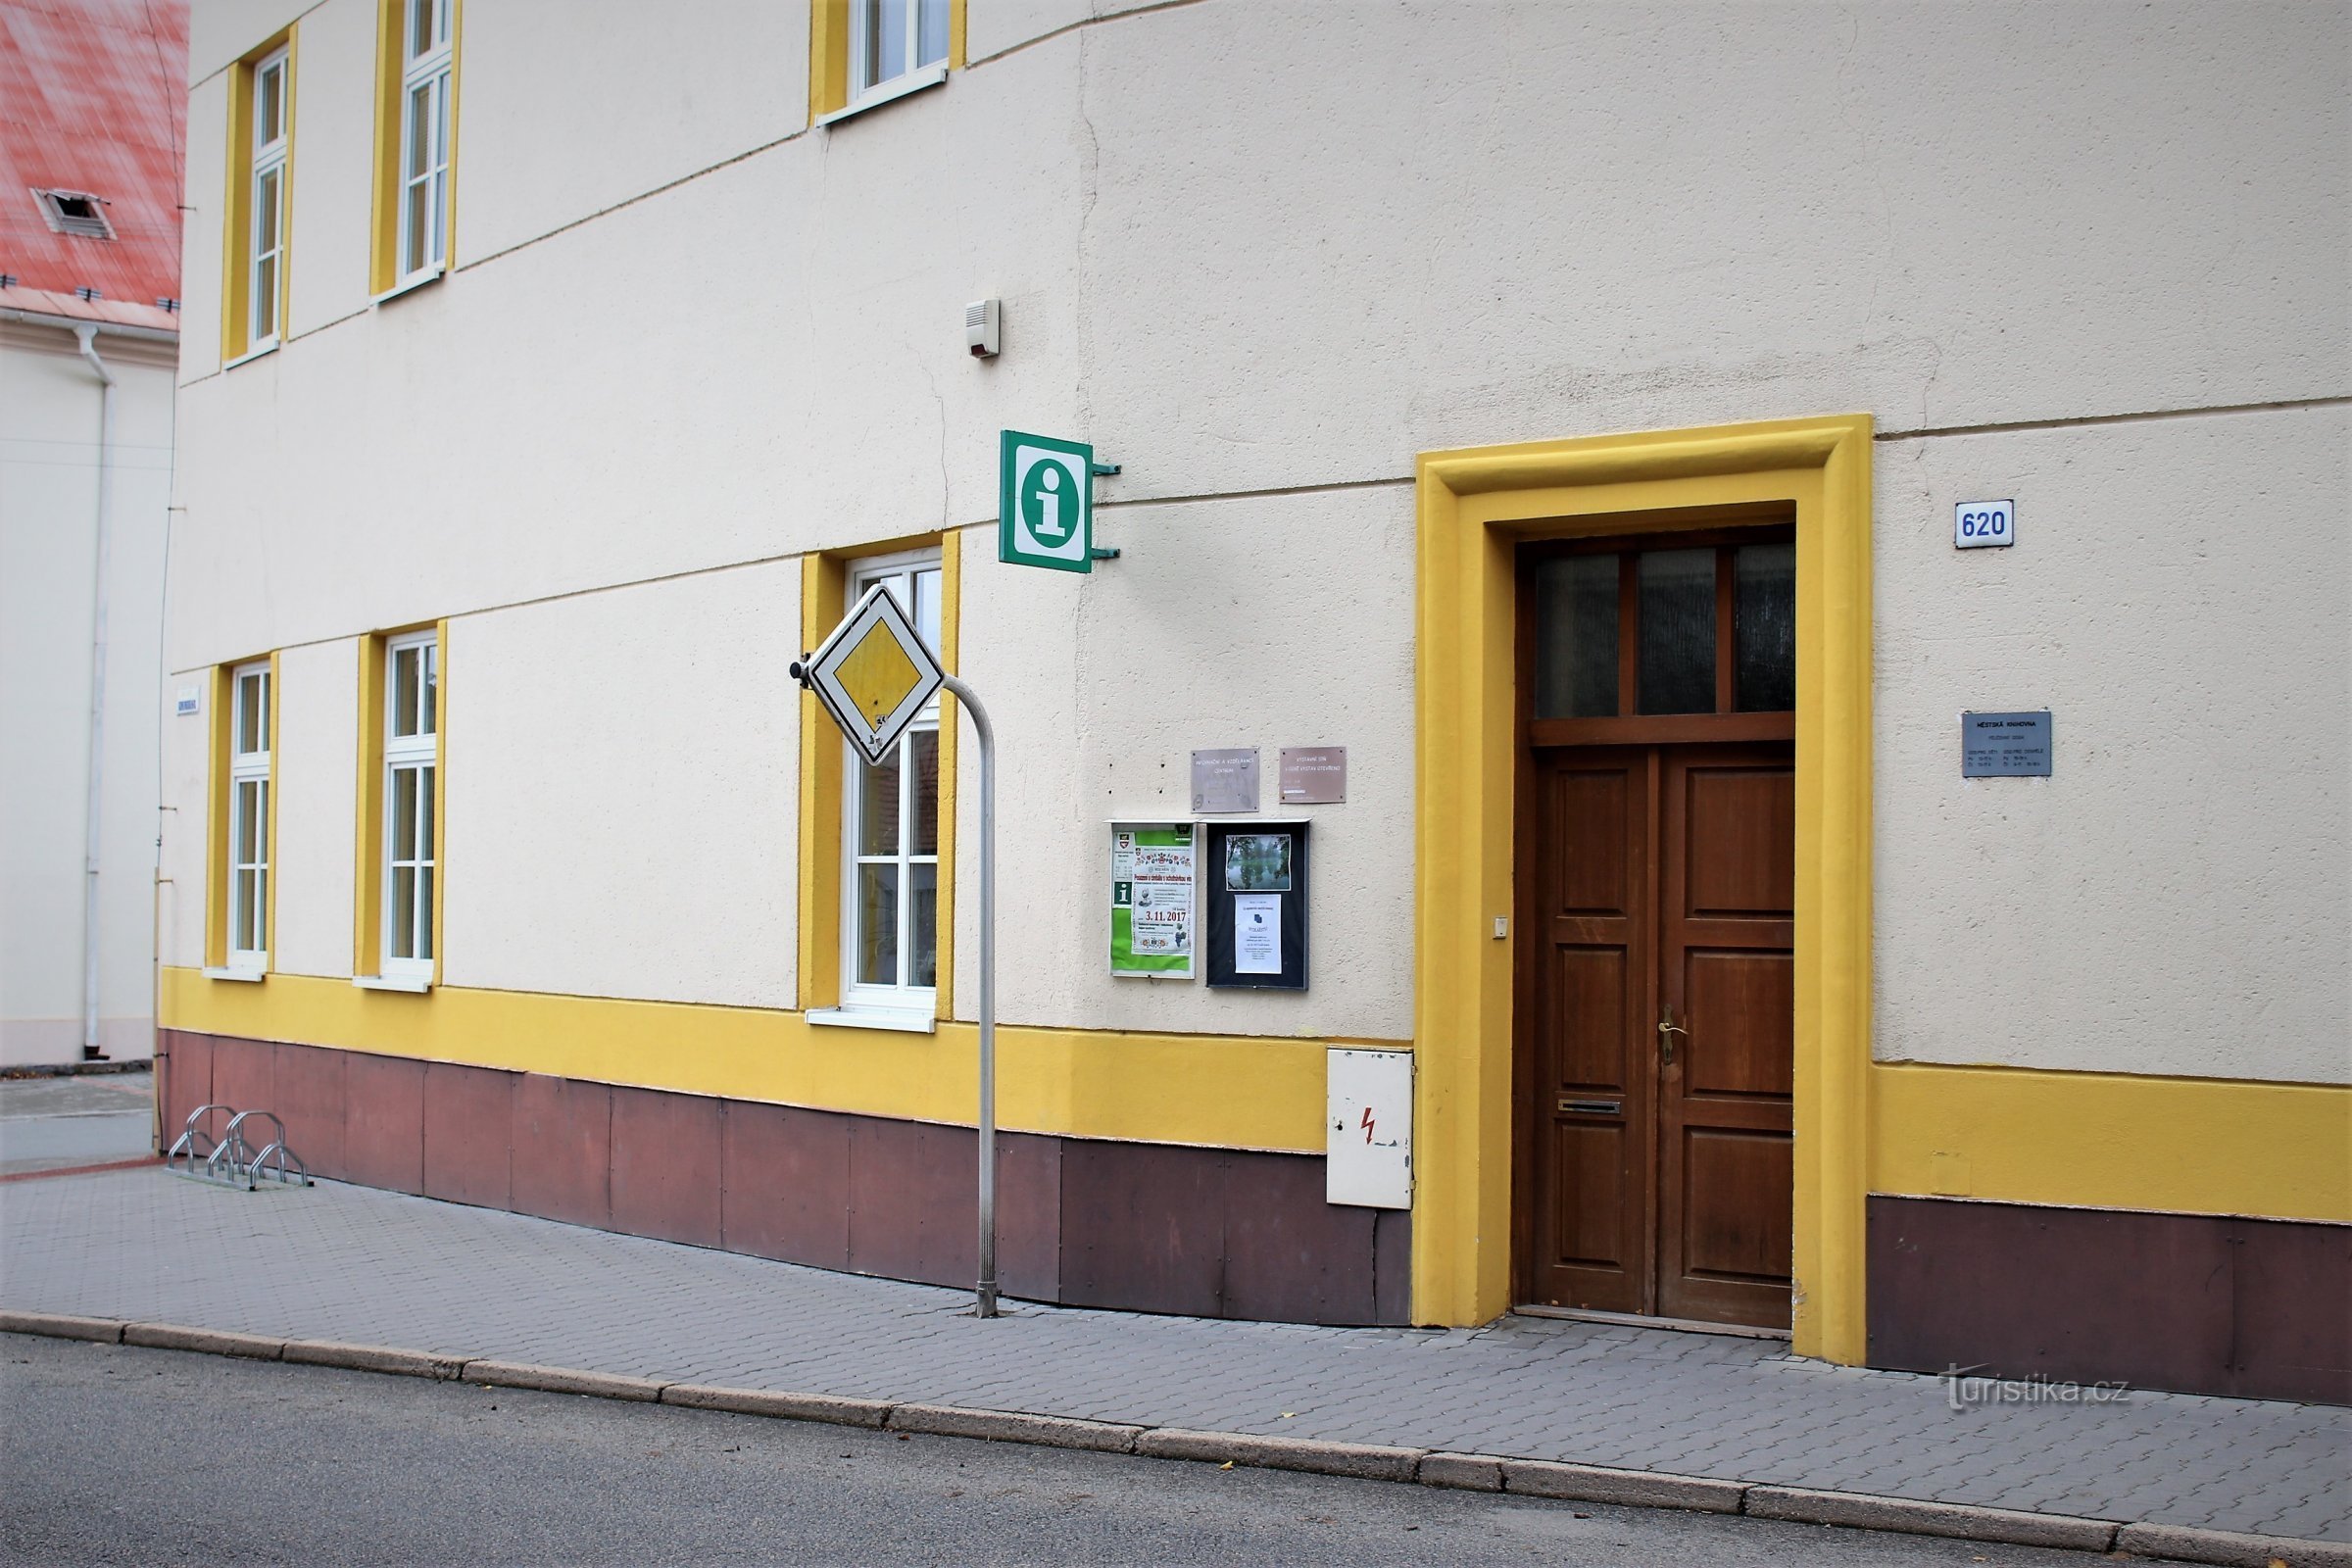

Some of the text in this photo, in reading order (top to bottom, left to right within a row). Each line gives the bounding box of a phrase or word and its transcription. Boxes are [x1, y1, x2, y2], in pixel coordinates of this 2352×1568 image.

[1962, 511, 2005, 537] 620
[1146, 910, 1187, 921] 3. 11. 2017
